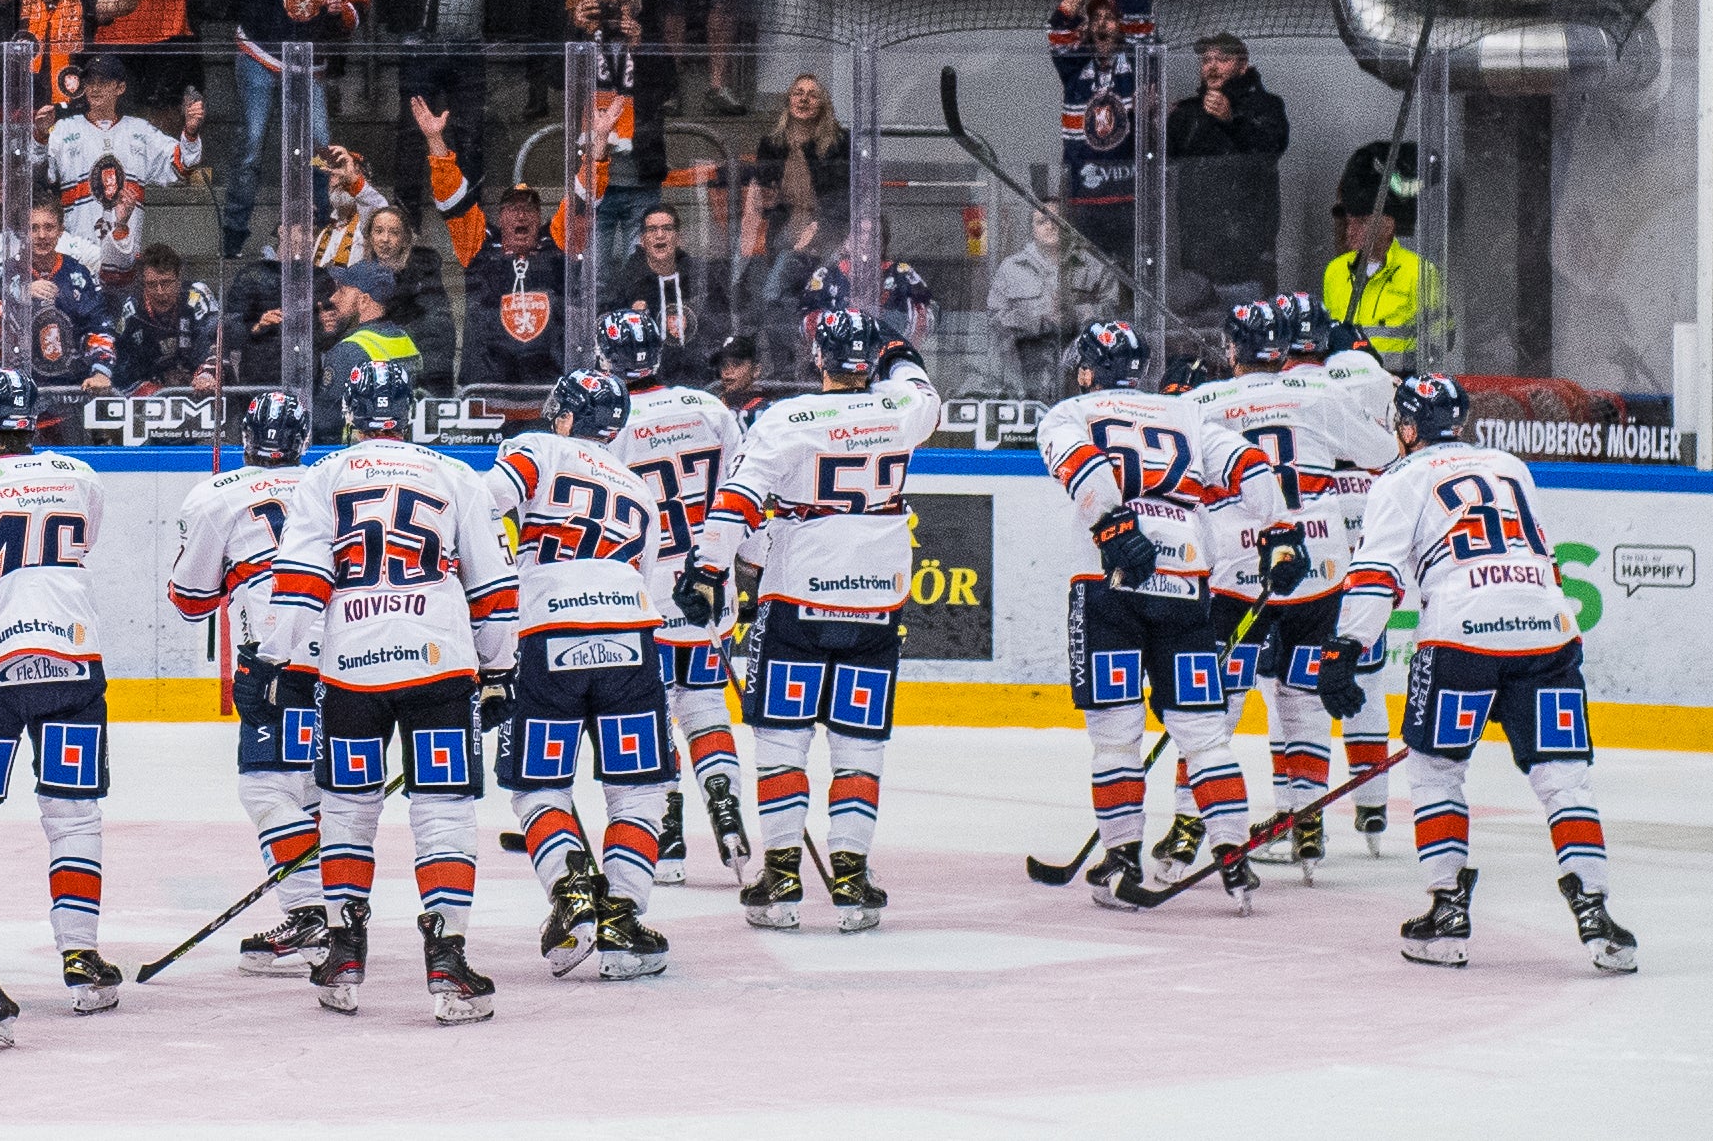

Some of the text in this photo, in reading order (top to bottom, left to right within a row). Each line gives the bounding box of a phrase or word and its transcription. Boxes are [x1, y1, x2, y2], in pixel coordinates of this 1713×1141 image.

[376, 396, 389, 408] 55
[439, 432, 504, 448] System AB
[1474, 416, 1682, 460] STRANDBERGS MÖBLER
[14, 461, 42, 470] CCM
[349, 458, 373, 470] ICA
[535, 471, 651, 566] 32
[1432, 472, 1557, 566] 31
[332, 482, 450, 593] 55
[808, 574, 891, 593] Sundström
[1621, 565, 1685, 580] HAPPIFY
[344, 593, 426, 624] KOIVISTO
[547, 590, 636, 614] Sundström
[1461, 616, 1553, 636] Sundström
[337, 644, 420, 672] Sundström
